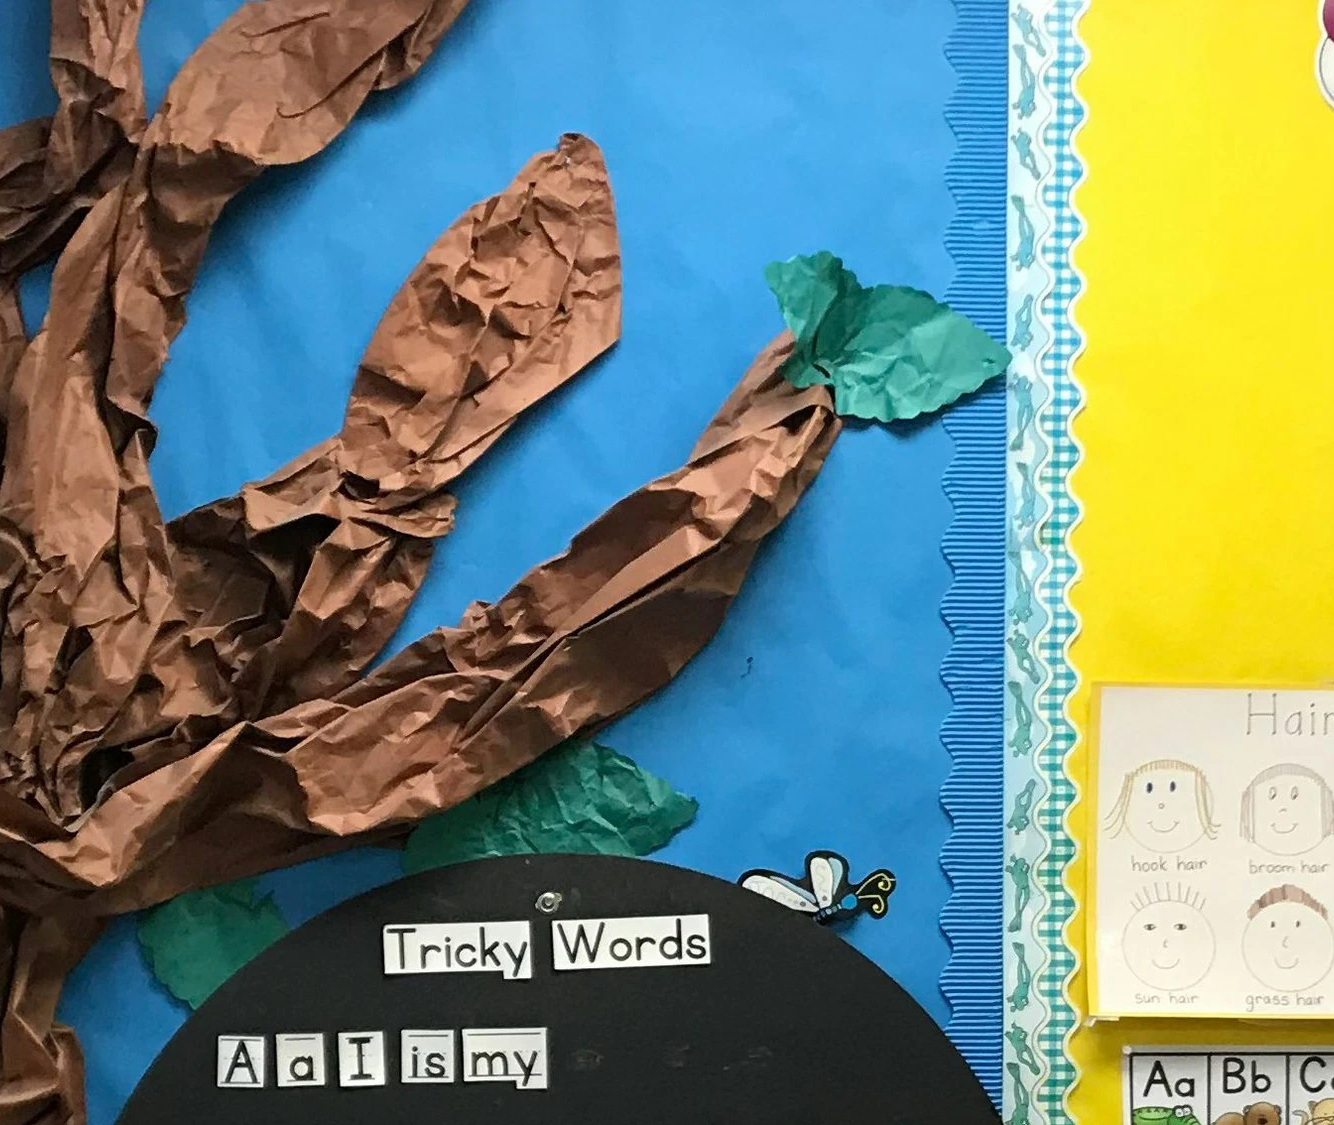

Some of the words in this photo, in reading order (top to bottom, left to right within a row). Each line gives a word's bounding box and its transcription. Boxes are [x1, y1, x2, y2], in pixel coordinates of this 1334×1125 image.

[1131, 856, 1167, 872] hook
[1177, 857, 1208, 871] hair
[1249, 860, 1295, 875] broom
[1302, 861, 1330, 874] hair
[386, 927, 528, 978] Tricky
[558, 919, 706, 964] Words
[1135, 995, 1164, 1004] sun
[1170, 992, 1199, 1004] hair
[1246, 994, 1291, 1011] grass
[1296, 993, 1324, 1006] hair
[224, 1040, 258, 1083] A
[289, 1056, 313, 1081] a
[347, 1036, 373, 1080] I
[411, 1046, 445, 1080] is
[472, 1049, 538, 1086] my
[1143, 1060, 1195, 1098] Aa
[1222, 1059, 1271, 1093] Bb
